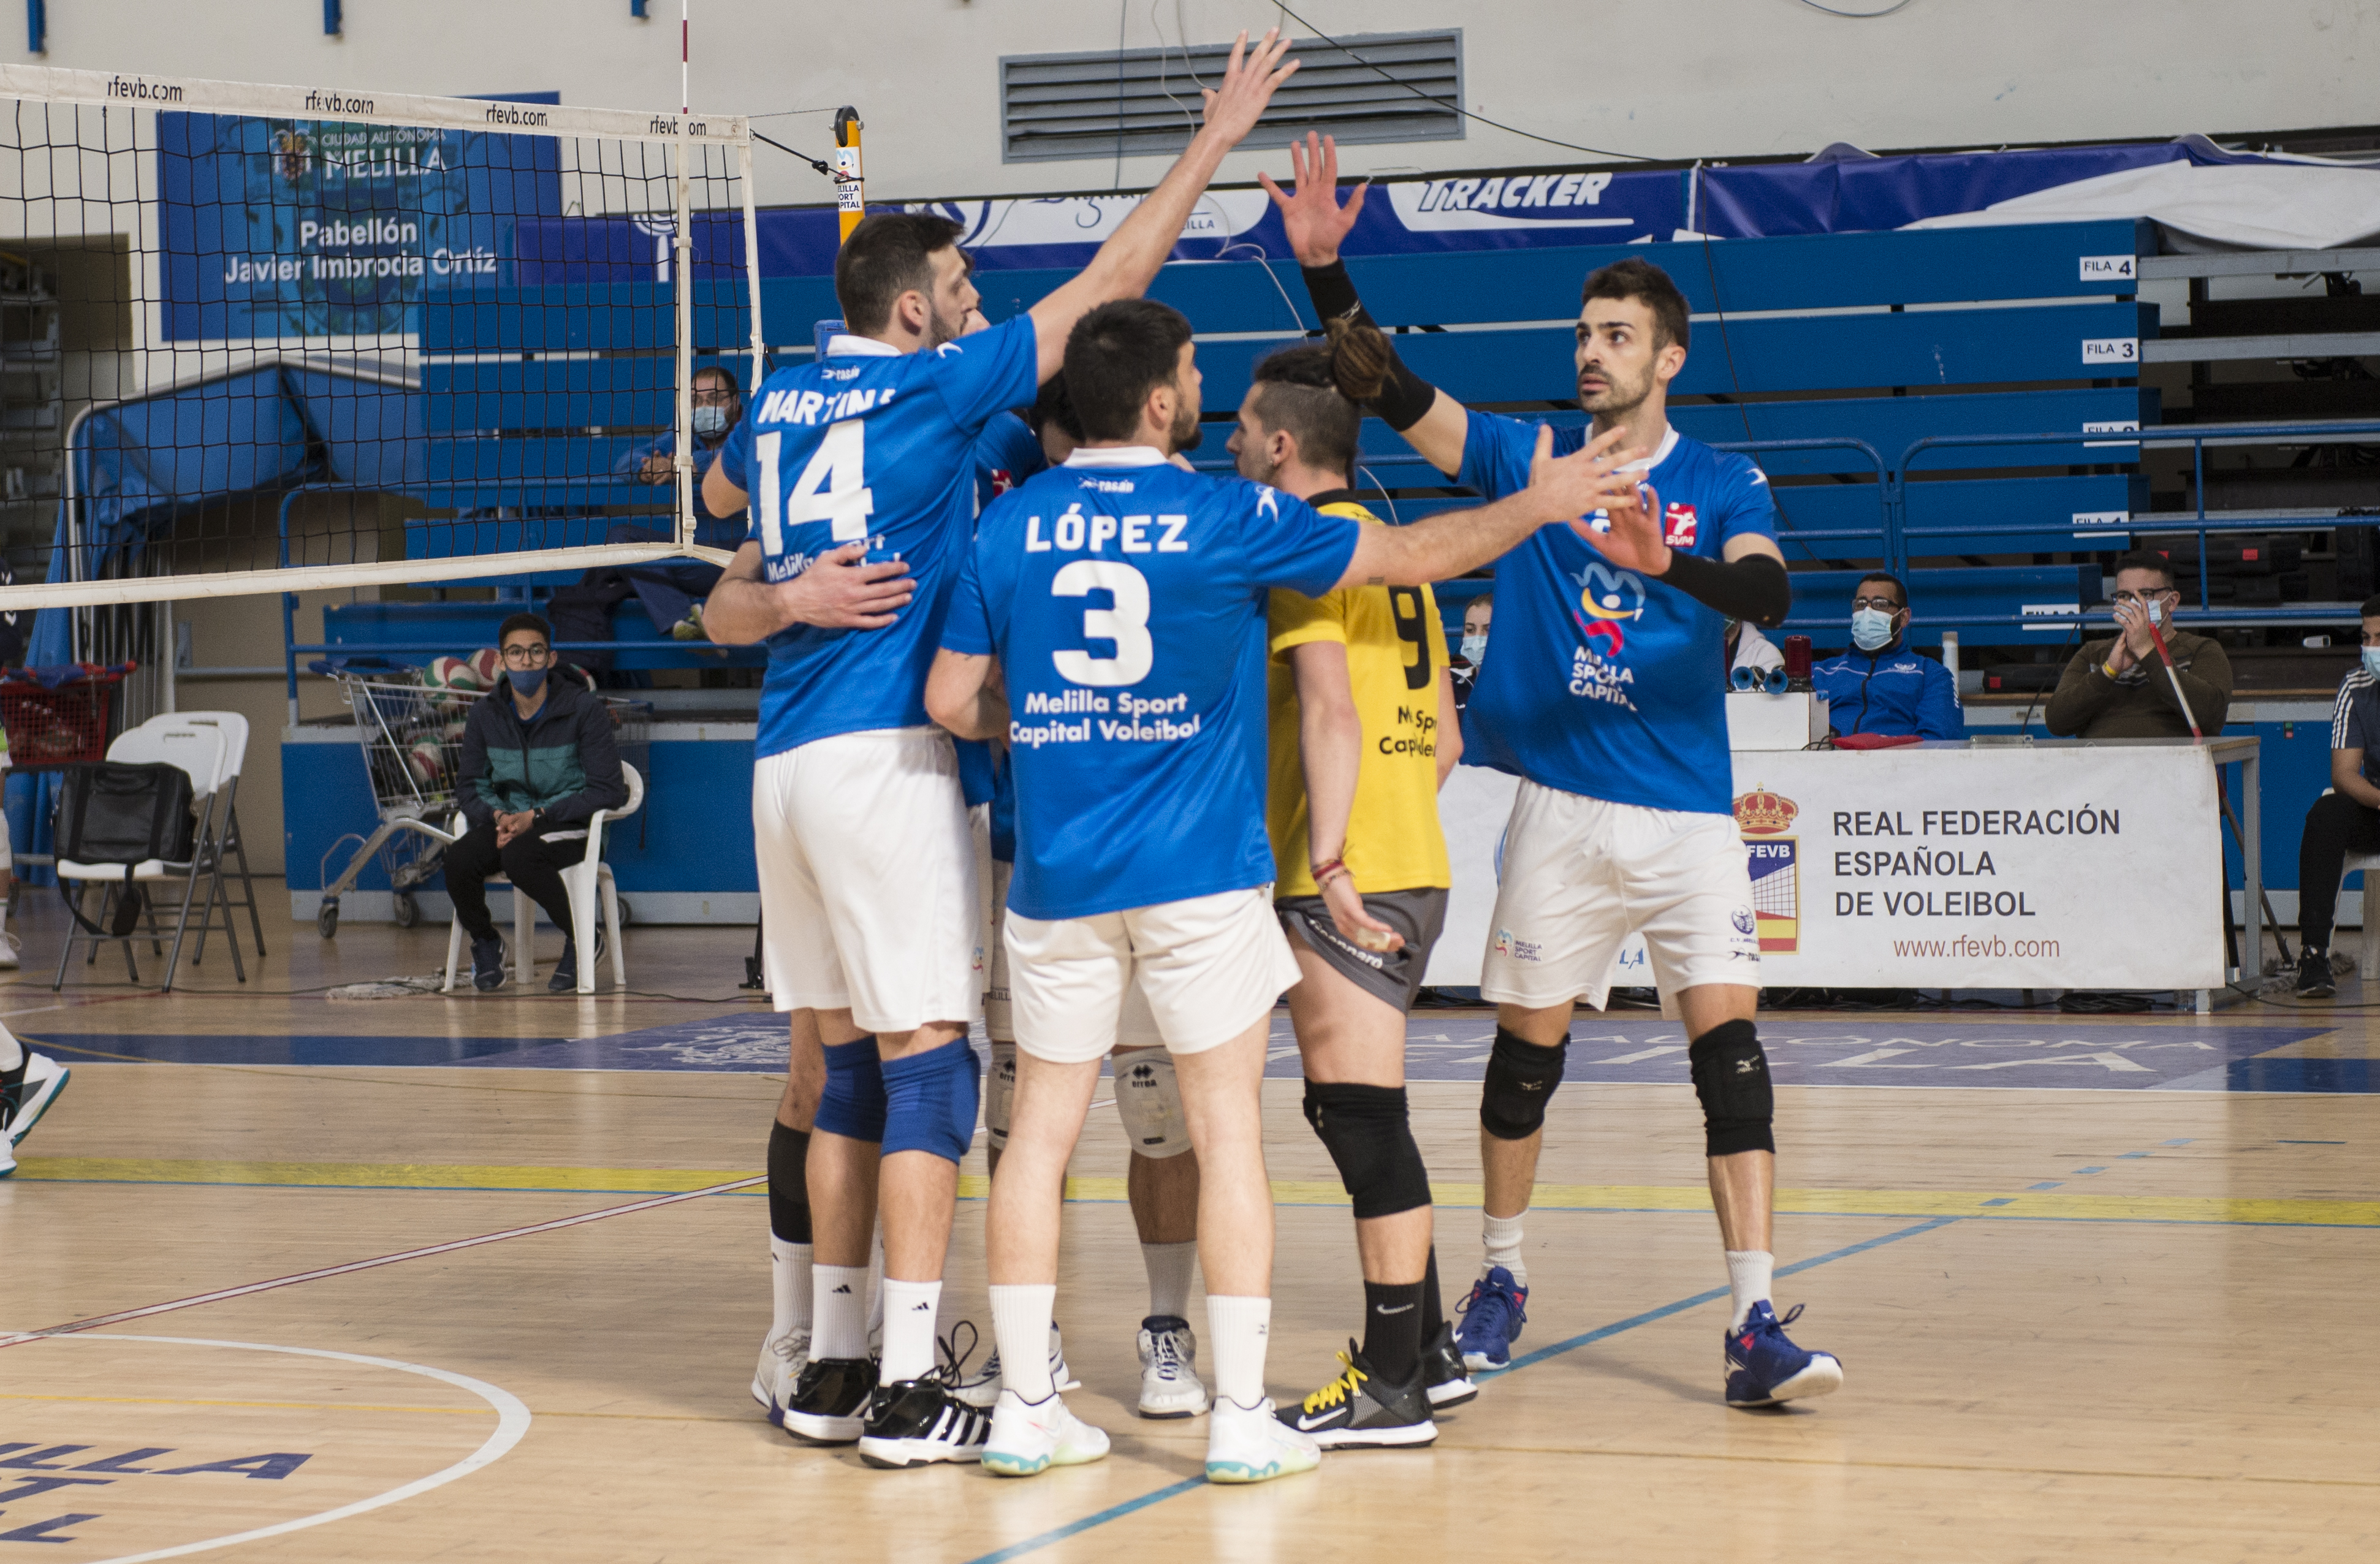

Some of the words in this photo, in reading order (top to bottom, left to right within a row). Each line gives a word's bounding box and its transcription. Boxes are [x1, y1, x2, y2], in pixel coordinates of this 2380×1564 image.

[485, 104, 547, 126] rfevb.com
[650, 115, 707, 135] rfevbom
[321, 132, 367, 146] CIUDAD
[324, 146, 447, 180] MELILLA
[1418, 172, 1613, 211] TRACKER
[300, 217, 417, 247] Pabellón
[225, 255, 305, 284] Javier
[313, 250, 424, 279] Imbroda
[432, 246, 498, 275] Ortíz
[2084, 260, 2112, 271] FILA
[2118, 260, 2131, 275] 4
[2086, 343, 2115, 354] FILA
[2122, 343, 2134, 357] 3
[756, 418, 873, 556] 14
[1025, 503, 1188, 552] LÓPEZ
[1665, 535, 1694, 545] SVM
[1051, 559, 1154, 686] 3
[1388, 586, 1431, 689] 9
[1025, 690, 1109, 714] Melilla
[1118, 693, 1188, 718] Sport
[1009, 718, 1090, 748] Capital
[1098, 714, 1201, 741] Voleibol
[1833, 811, 1913, 836] REAL
[1923, 803, 2120, 835] FEDERACIÓN
[1834, 846, 1996, 876] ESPAÑOLA
[1836, 891, 1873, 916] DE
[1883, 890, 2036, 916] VOLEIBOL
[1514, 952, 1541, 961] CAPITAL
[1515, 940, 1542, 949] MELILLA
[1515, 946, 1536, 955] SPORT
[1893, 935, 2060, 958] www.rfevb.com
